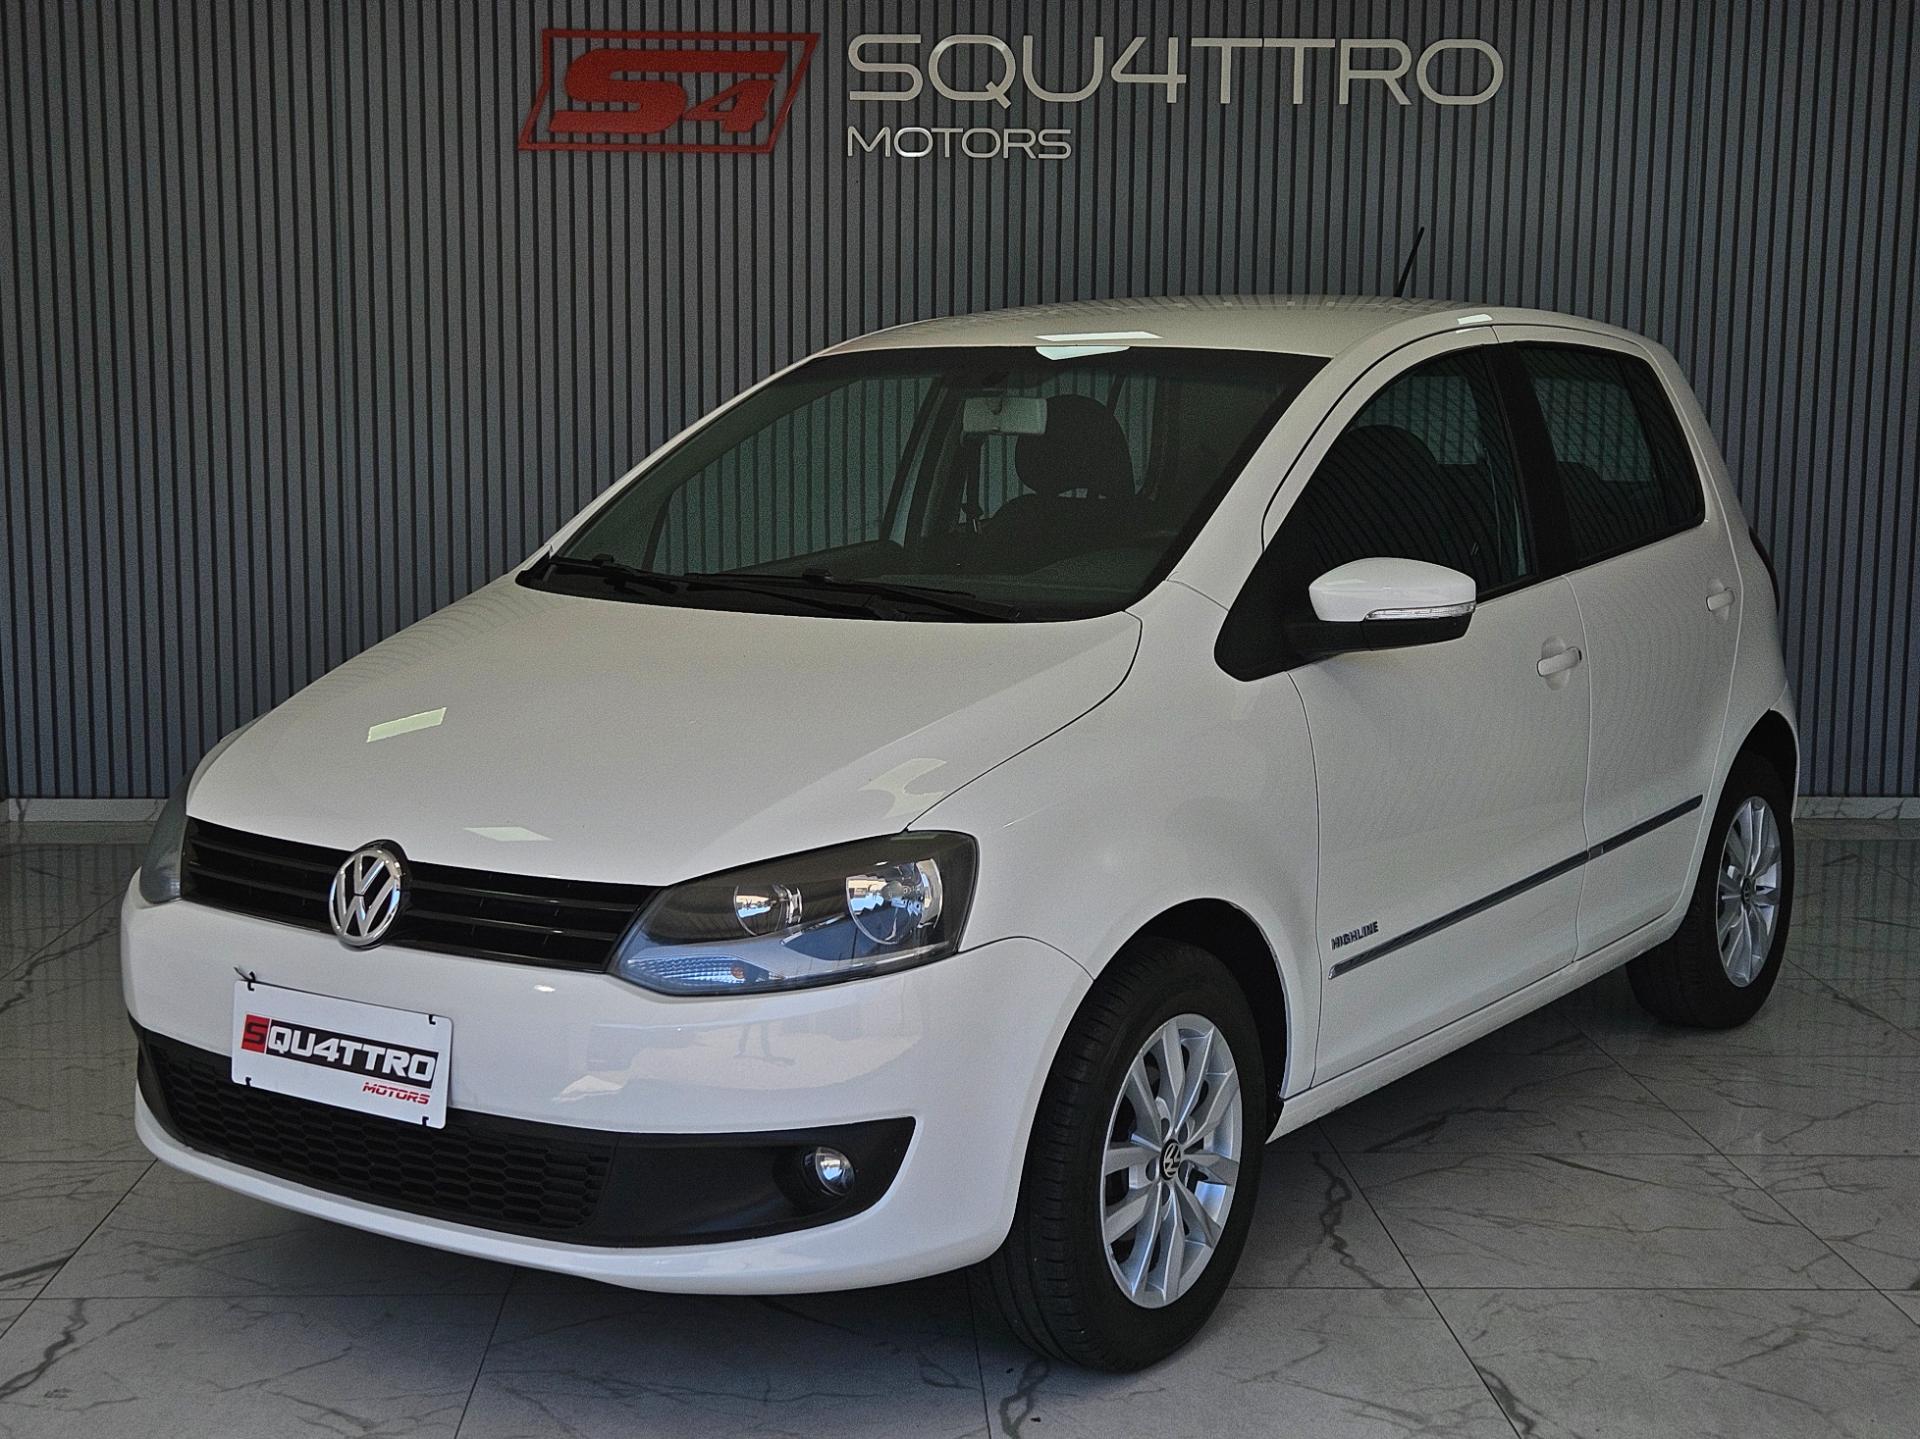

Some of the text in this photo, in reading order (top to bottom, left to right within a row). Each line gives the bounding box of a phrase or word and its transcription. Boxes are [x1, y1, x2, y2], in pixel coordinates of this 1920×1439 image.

[547, 48, 786, 133] S4
[848, 33, 1504, 109] SQU4TTRO
[847, 126, 1072, 159] MOTORS
[1331, 921, 1379, 950] HIGHLINE
[242, 1020, 437, 1082] SQU4TTRO
[362, 1082, 430, 1105] MOTORS
